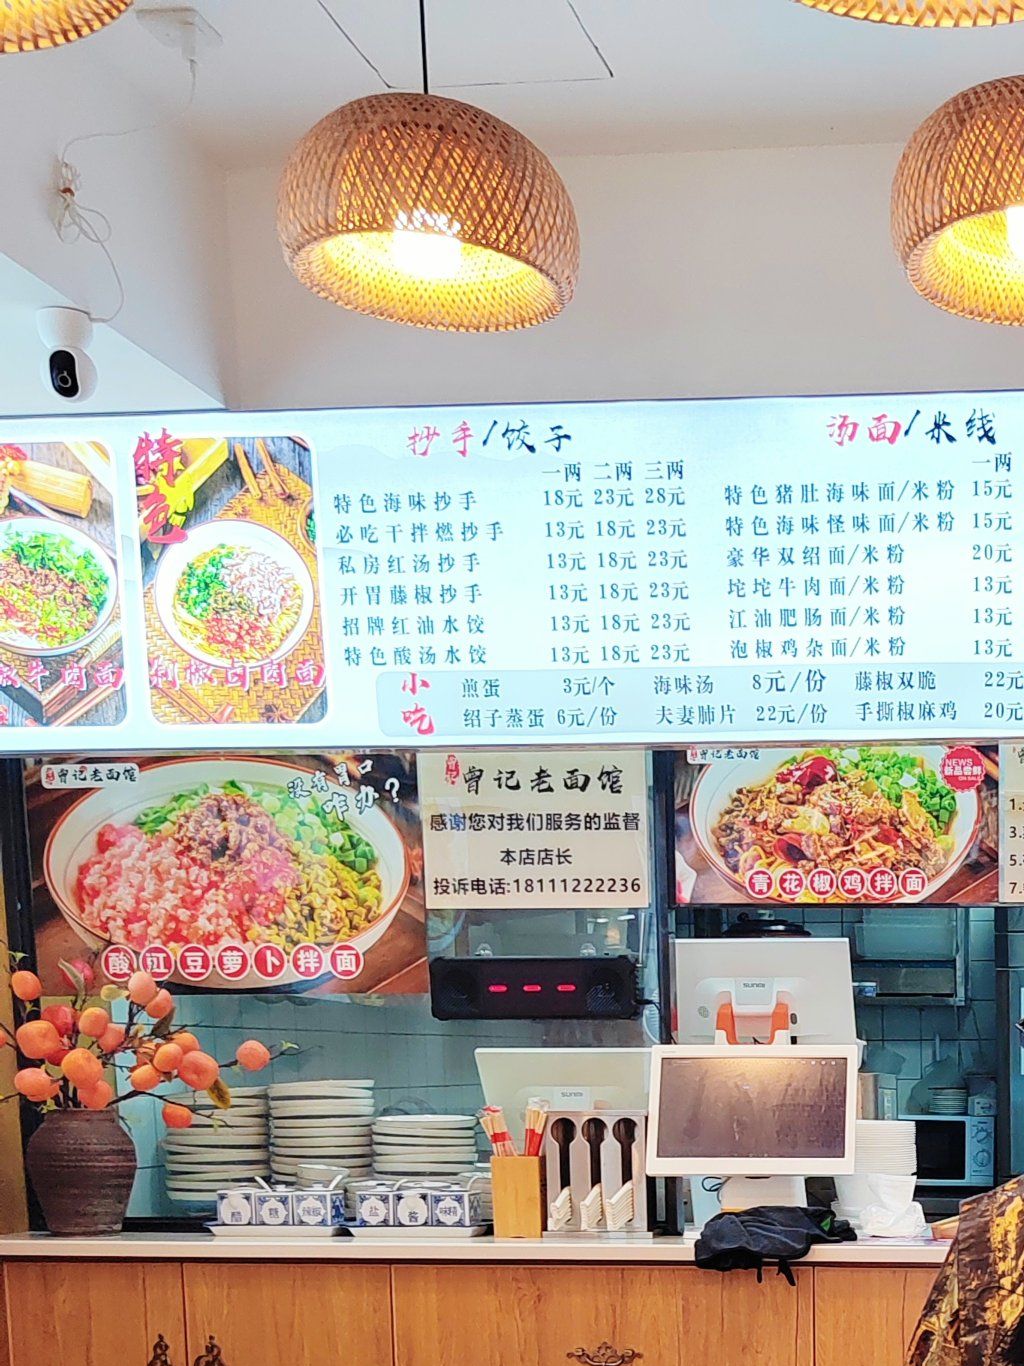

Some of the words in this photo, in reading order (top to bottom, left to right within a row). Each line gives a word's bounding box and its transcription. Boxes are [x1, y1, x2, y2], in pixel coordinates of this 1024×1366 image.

[407, 419, 572, 457] 抄手/饺子
[827, 408, 997, 446] 汤面/米线
[543, 462, 581, 482] 一两
[595, 461, 632, 481] 二两
[645, 459, 684, 480] 三两
[973, 452, 1011, 472] 一两
[132, 427, 188, 543] 特色
[725, 480, 954, 506] 特色猪肚海味面/米粉
[973, 479, 1012, 499] 15元
[334, 491, 476, 514] 特色海味抄手
[544, 489, 583, 508] 18元
[594, 488, 634, 507] 23元
[645, 486, 685, 506] 28元
[336, 521, 503, 544] 必吃干拌燃抄手
[546, 521, 584, 539] 13元
[597, 520, 636, 539] 18元
[647, 518, 686, 537] 23元
[725, 511, 955, 537] 特色海味怪味面/米粉
[973, 511, 1012, 531] 15元
[338, 552, 480, 575] 私房红汤抄手
[548, 552, 586, 571] 13元
[598, 551, 637, 570] 18元
[648, 550, 687, 569] 23元
[727, 544, 904, 567] 豪华双绍面/米粉
[973, 543, 1012, 562] 20元
[342, 584, 482, 605] 开胃藤椒抄手
[550, 584, 588, 602] 13元
[600, 583, 638, 601] 18元
[650, 581, 689, 600] 23元
[973, 575, 1012, 594] 13元
[342, 615, 484, 636] 招牌红油水饺
[552, 615, 589, 633] 13元
[602, 613, 640, 632] 18元
[651, 613, 690, 631] 23元
[729, 606, 905, 629] 江油肥肠面/米粉
[973, 607, 1012, 626] 13元
[344, 645, 486, 666] 特色酸汤水饺
[552, 646, 589, 664] 13元
[602, 645, 640, 663] 18元
[651, 644, 690, 662] 23元
[730, 636, 906, 659] 泡椒鸡杂面/米粉
[973, 639, 1012, 657] 13元
[463, 679, 500, 698] 煎蛋
[564, 676, 615, 696] 3元/个
[654, 675, 713, 695] 海味汤
[753, 669, 826, 693] 8元/份
[855, 671, 936, 691] 藤椒双脆
[402, 673, 434, 735] 小吃
[656, 704, 735, 725] 夫妻肺片
[757, 704, 827, 724] 22元/份
[856, 700, 957, 721] 手撕椒麻鸡
[464, 708, 544, 728] 绍子蒸蛋
[557, 707, 618, 727] 6元/份
[945, 758, 973, 767] NEWS
[58, 766, 136, 784] 曾记老面馆
[463, 765, 624, 795] 曾记老面馆
[430, 813, 641, 832] 感谢您对我们服务的监督
[500, 848, 573, 866] 本店店长
[433, 878, 641, 896] 投诉电话:18111222236
[751, 872, 924, 893] 青花椒鸡拌面
